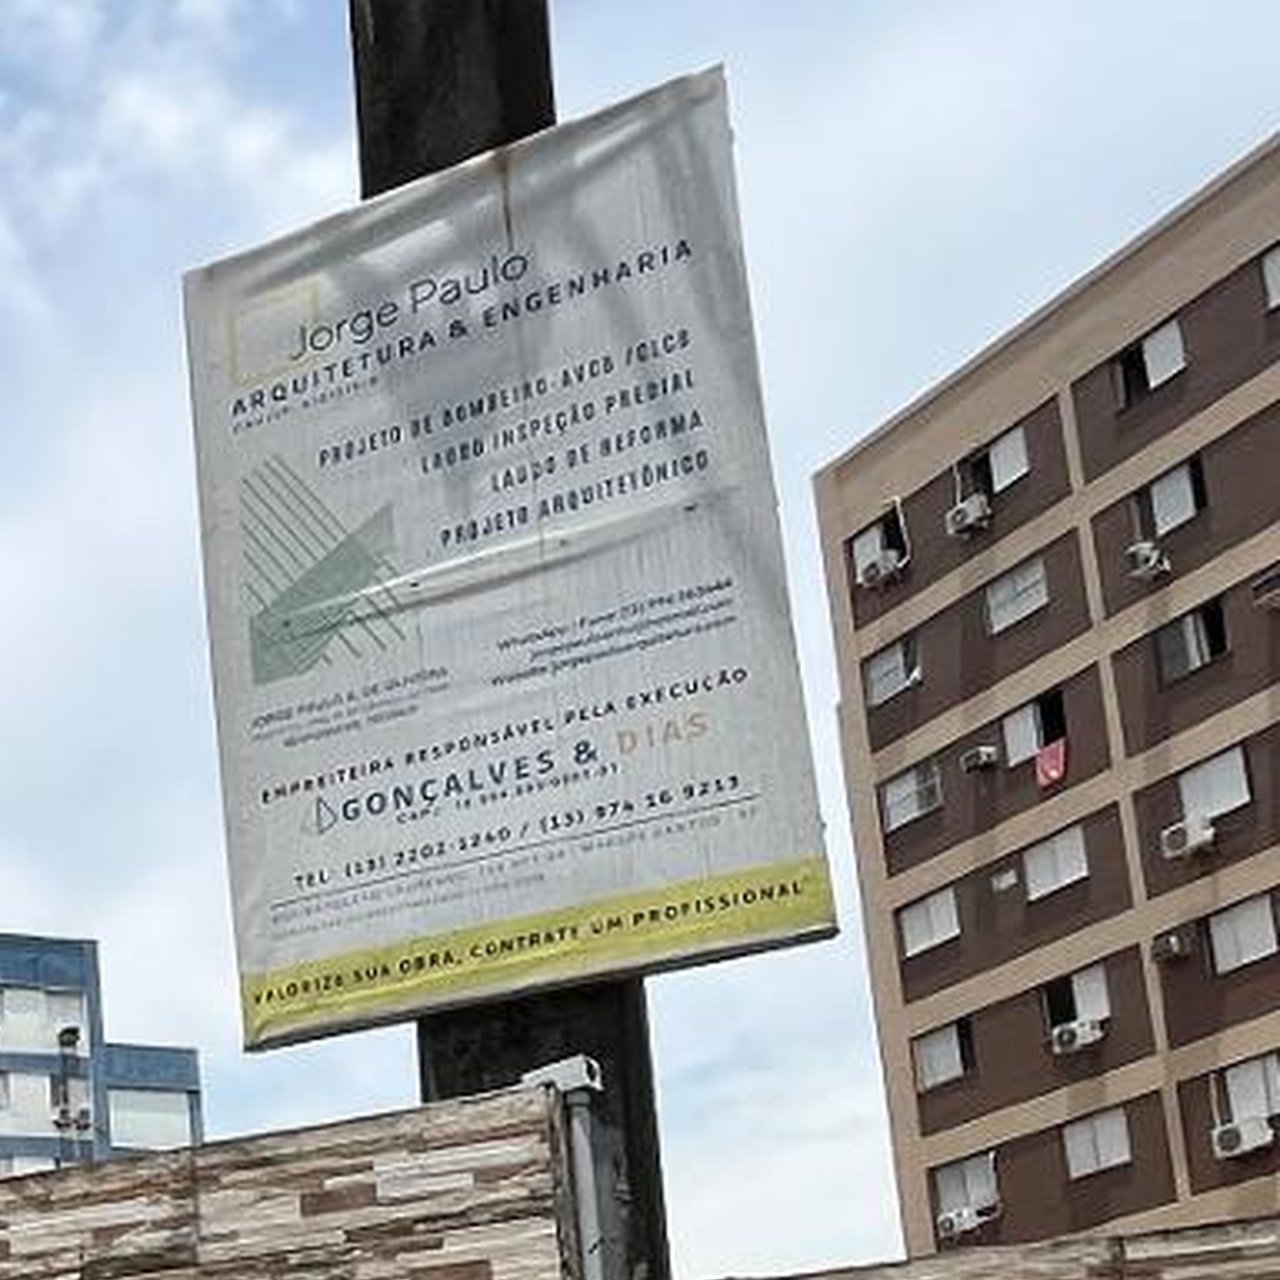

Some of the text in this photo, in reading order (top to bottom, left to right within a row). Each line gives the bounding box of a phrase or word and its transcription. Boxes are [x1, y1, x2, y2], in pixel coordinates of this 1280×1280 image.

[231, 327, 437, 417] ARQUITETURA
[448, 316, 467, 341] &
[481, 236, 692, 329] ENGENHARIA
[287, 250, 528, 361] Jorge Paulo
[318, 423, 402, 469] PROJETO
[410, 413, 432, 438] DE
[491, 401, 596, 450] INSPEÇÃO
[604, 368, 695, 415] PREDIAL
[491, 407, 703, 492] LAUDO DE REFORMA
[439, 445, 710, 549] PROJETO ARQUITETÔNICO
[261, 756, 395, 804] EMPREITEIRA
[404, 713, 553, 767] RESPONSÁVEL
[564, 699, 615, 726] PELA
[625, 664, 748, 712] EXECUÇÃO
[341, 748, 556, 826] GONÇALVES
[572, 736, 599, 765] &
[616, 709, 712, 756] DIAS
[253, 878, 802, 1005] VALORIZE SUA OBRA, CONTRATE UM PROFISSIONAL
